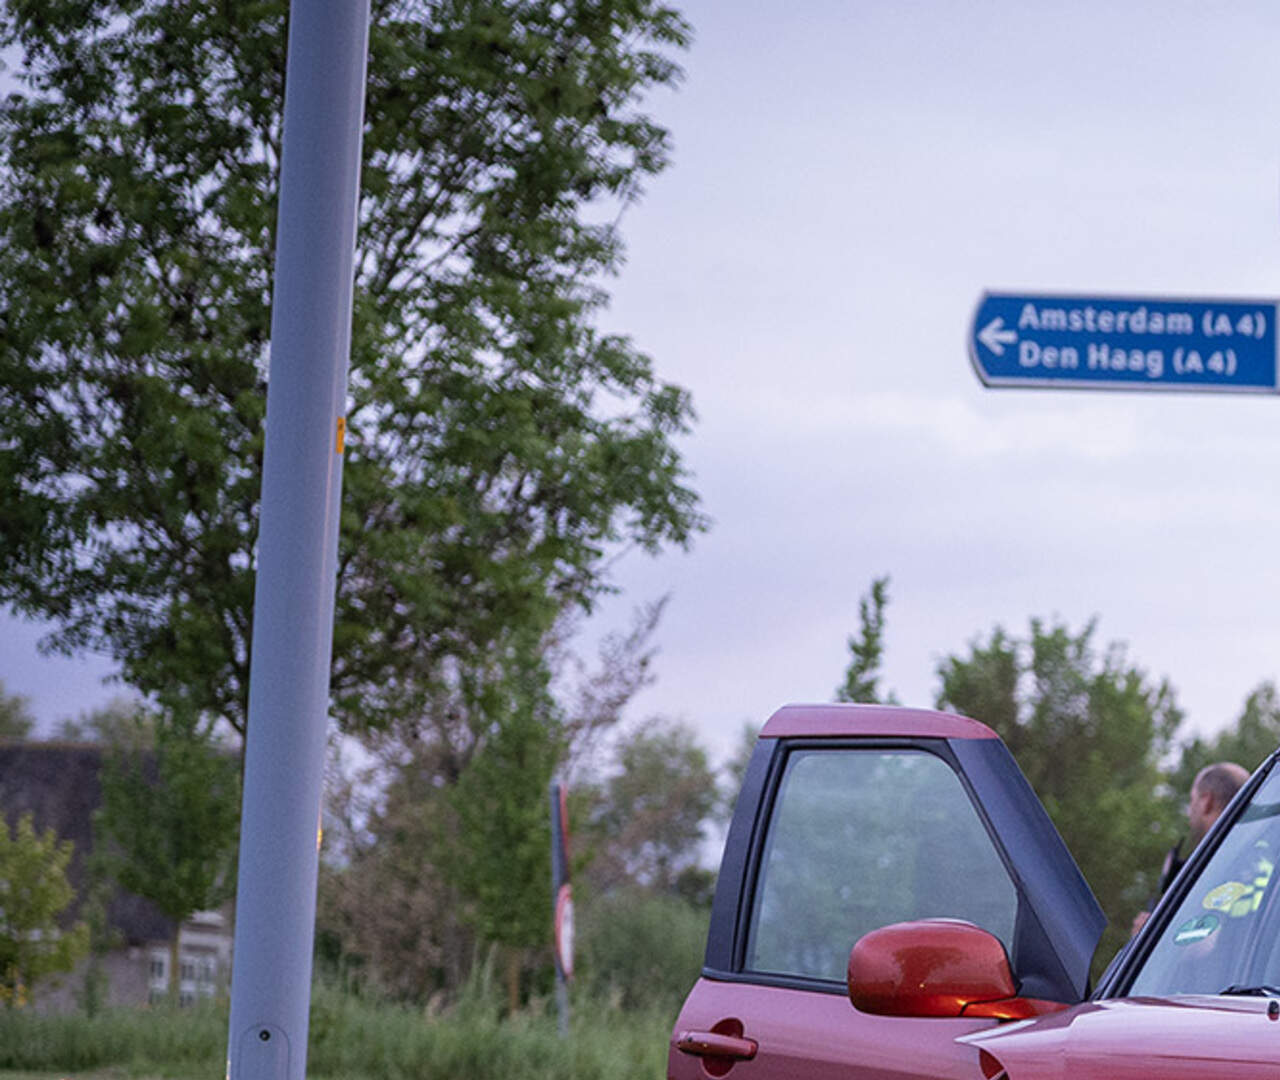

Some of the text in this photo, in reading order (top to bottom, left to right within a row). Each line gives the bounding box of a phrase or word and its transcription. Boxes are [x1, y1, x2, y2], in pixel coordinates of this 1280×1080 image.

[1018, 303, 1193, 335] Amsterdam
[1019, 340, 1078, 368] Den
[1087, 343, 1164, 378] Haag
